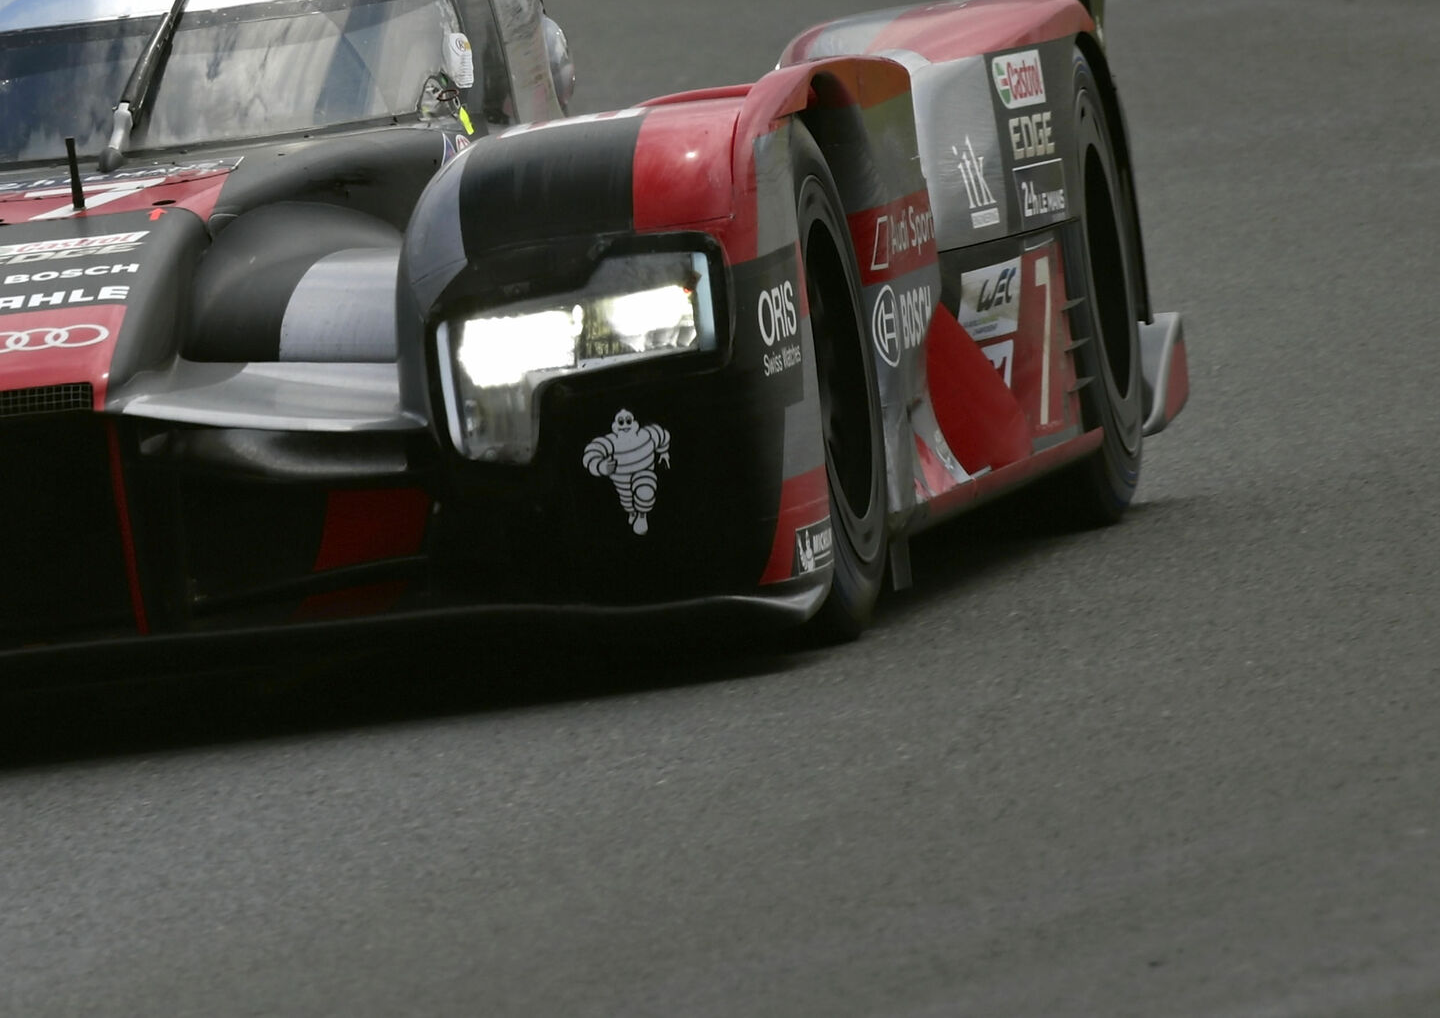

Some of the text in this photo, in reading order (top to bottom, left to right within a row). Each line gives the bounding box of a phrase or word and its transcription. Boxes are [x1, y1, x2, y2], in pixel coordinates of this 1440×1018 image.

[1006, 57, 1043, 100] Castrol
[1008, 111, 1056, 160] EDGE
[23, 177, 167, 221] 7
[15, 233, 133, 254] Castrol
[890, 209, 910, 255] Audi
[908, 205, 936, 256] Sport
[3, 263, 141, 285] BOSCH
[757, 279, 797, 347] ORIS
[899, 285, 933, 350] BOSCH
[763, 351, 784, 377] Swiss
